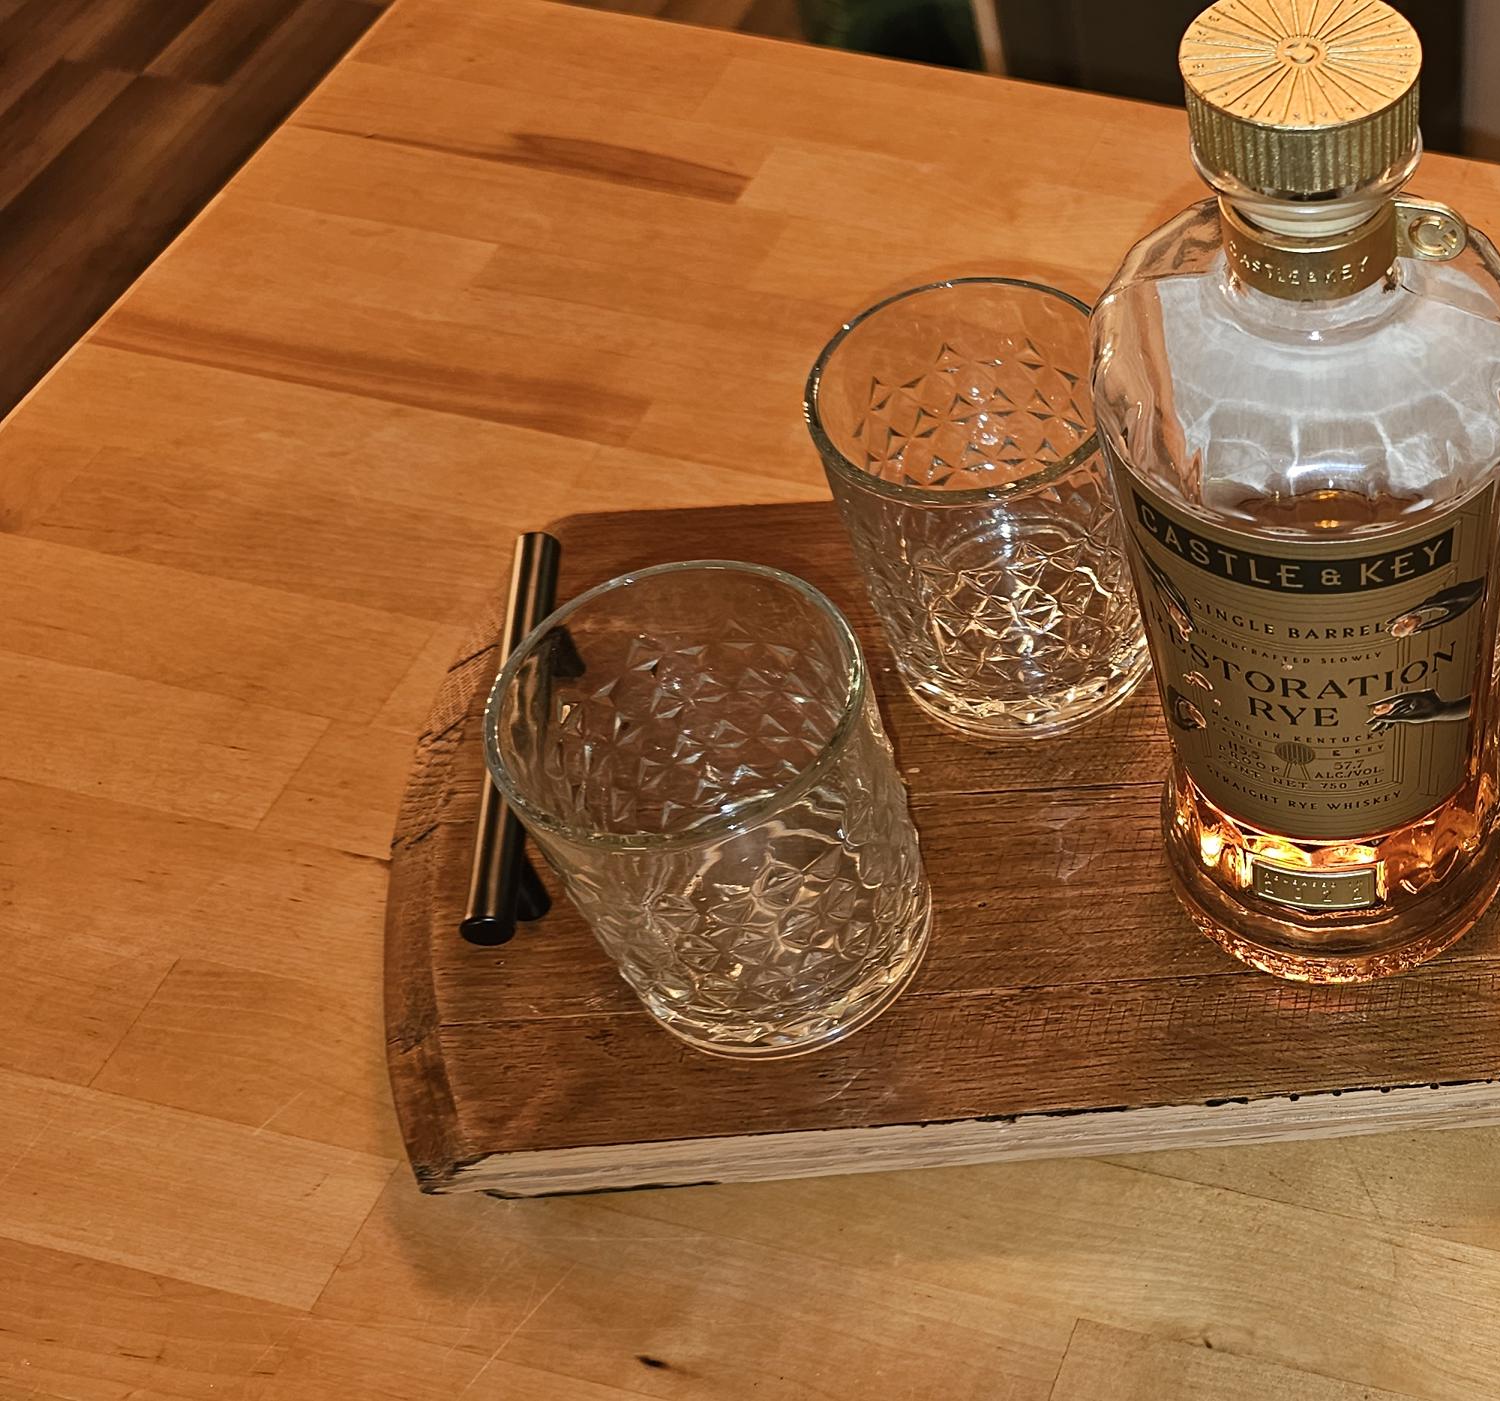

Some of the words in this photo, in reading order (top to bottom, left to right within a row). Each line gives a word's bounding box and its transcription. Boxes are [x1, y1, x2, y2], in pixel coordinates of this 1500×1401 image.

[1141, 506, 1305, 589] CASTLE
[1319, 568, 1342, 586] &
[1360, 538, 1445, 587] KEY
[1193, 597, 1275, 636] SINGLE
[1288, 622, 1386, 640] BARREL
[1201, 628, 1310, 665] HANDCRAFTED
[1321, 651, 1382, 665] SLOWLY
[1247, 695, 1340, 727] RYE
[1263, 729, 1281, 739] IN
[1293, 730, 1386, 744] KENTUCKY
[1354, 743, 1384, 755] KEY
[1218, 743, 1280, 773] PROOF
[1287, 800, 1318, 810] RYE
[1326, 790, 1402, 811] WHISKEY
[1320, 782, 1348, 790] 750
